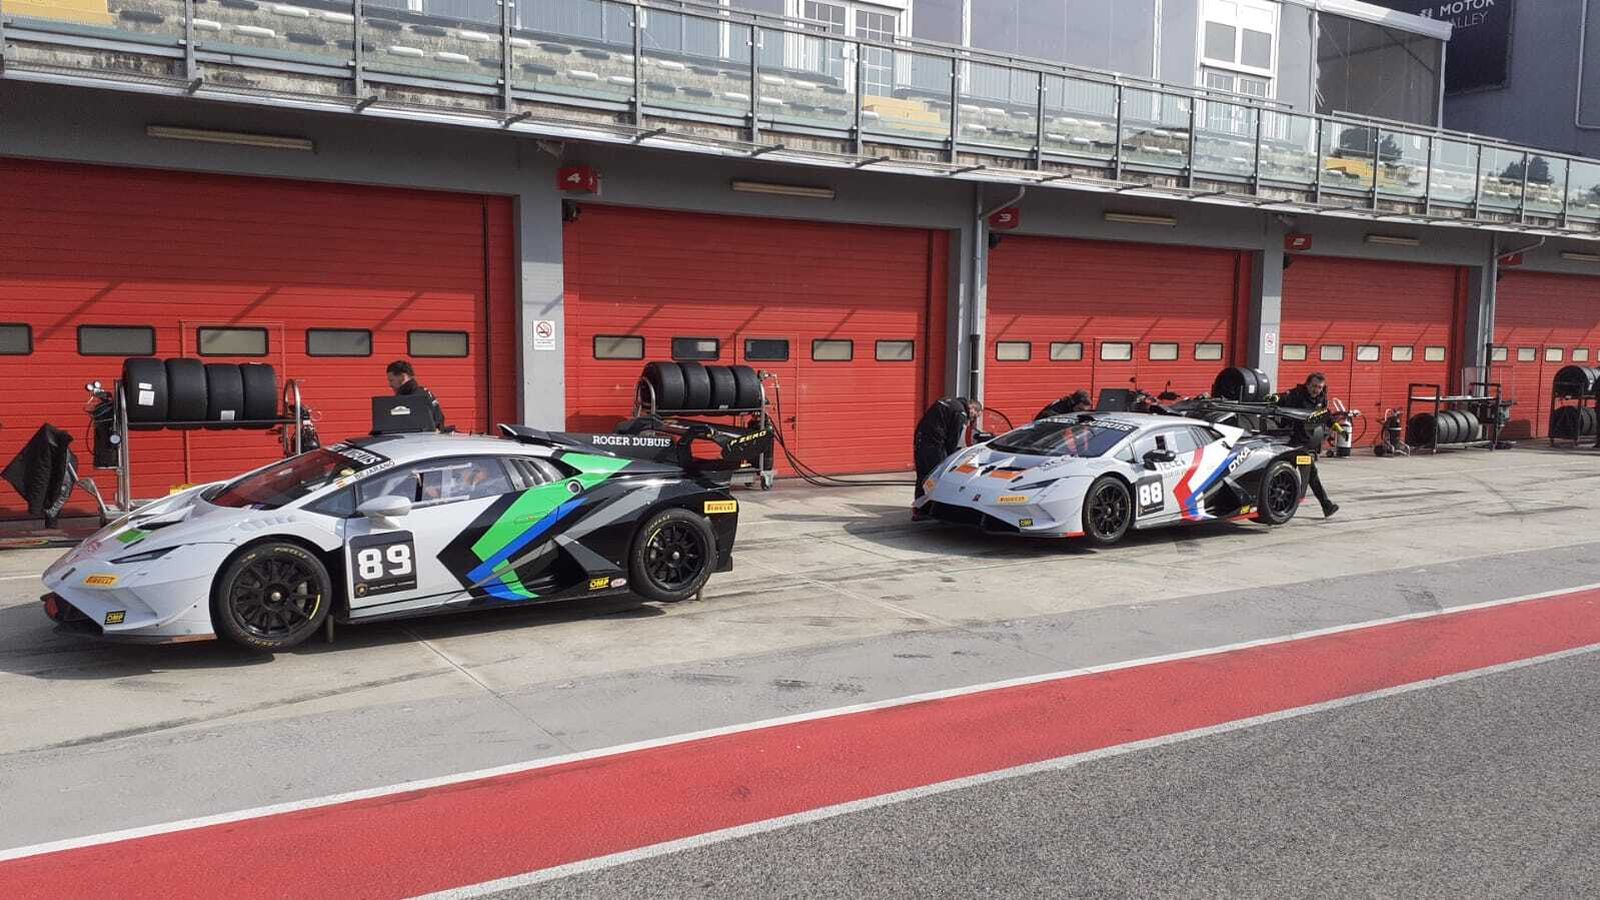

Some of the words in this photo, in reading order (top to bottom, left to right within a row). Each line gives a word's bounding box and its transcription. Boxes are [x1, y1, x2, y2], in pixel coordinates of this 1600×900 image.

[1440, 0, 1495, 16] MOTOR
[1450, 11, 1489, 28] ALLEY
[567, 173, 581, 183] 4
[999, 213, 1012, 222] 3
[592, 435, 631, 446] ROGER
[632, 437, 671, 448] DUBUIS
[1228, 446, 1251, 473] DYKA
[1140, 481, 1162, 506] 88
[707, 503, 734, 511] PIRELLI
[357, 544, 413, 580] 89
[590, 577, 609, 589] OMP
[106, 612, 125, 623] OMP
